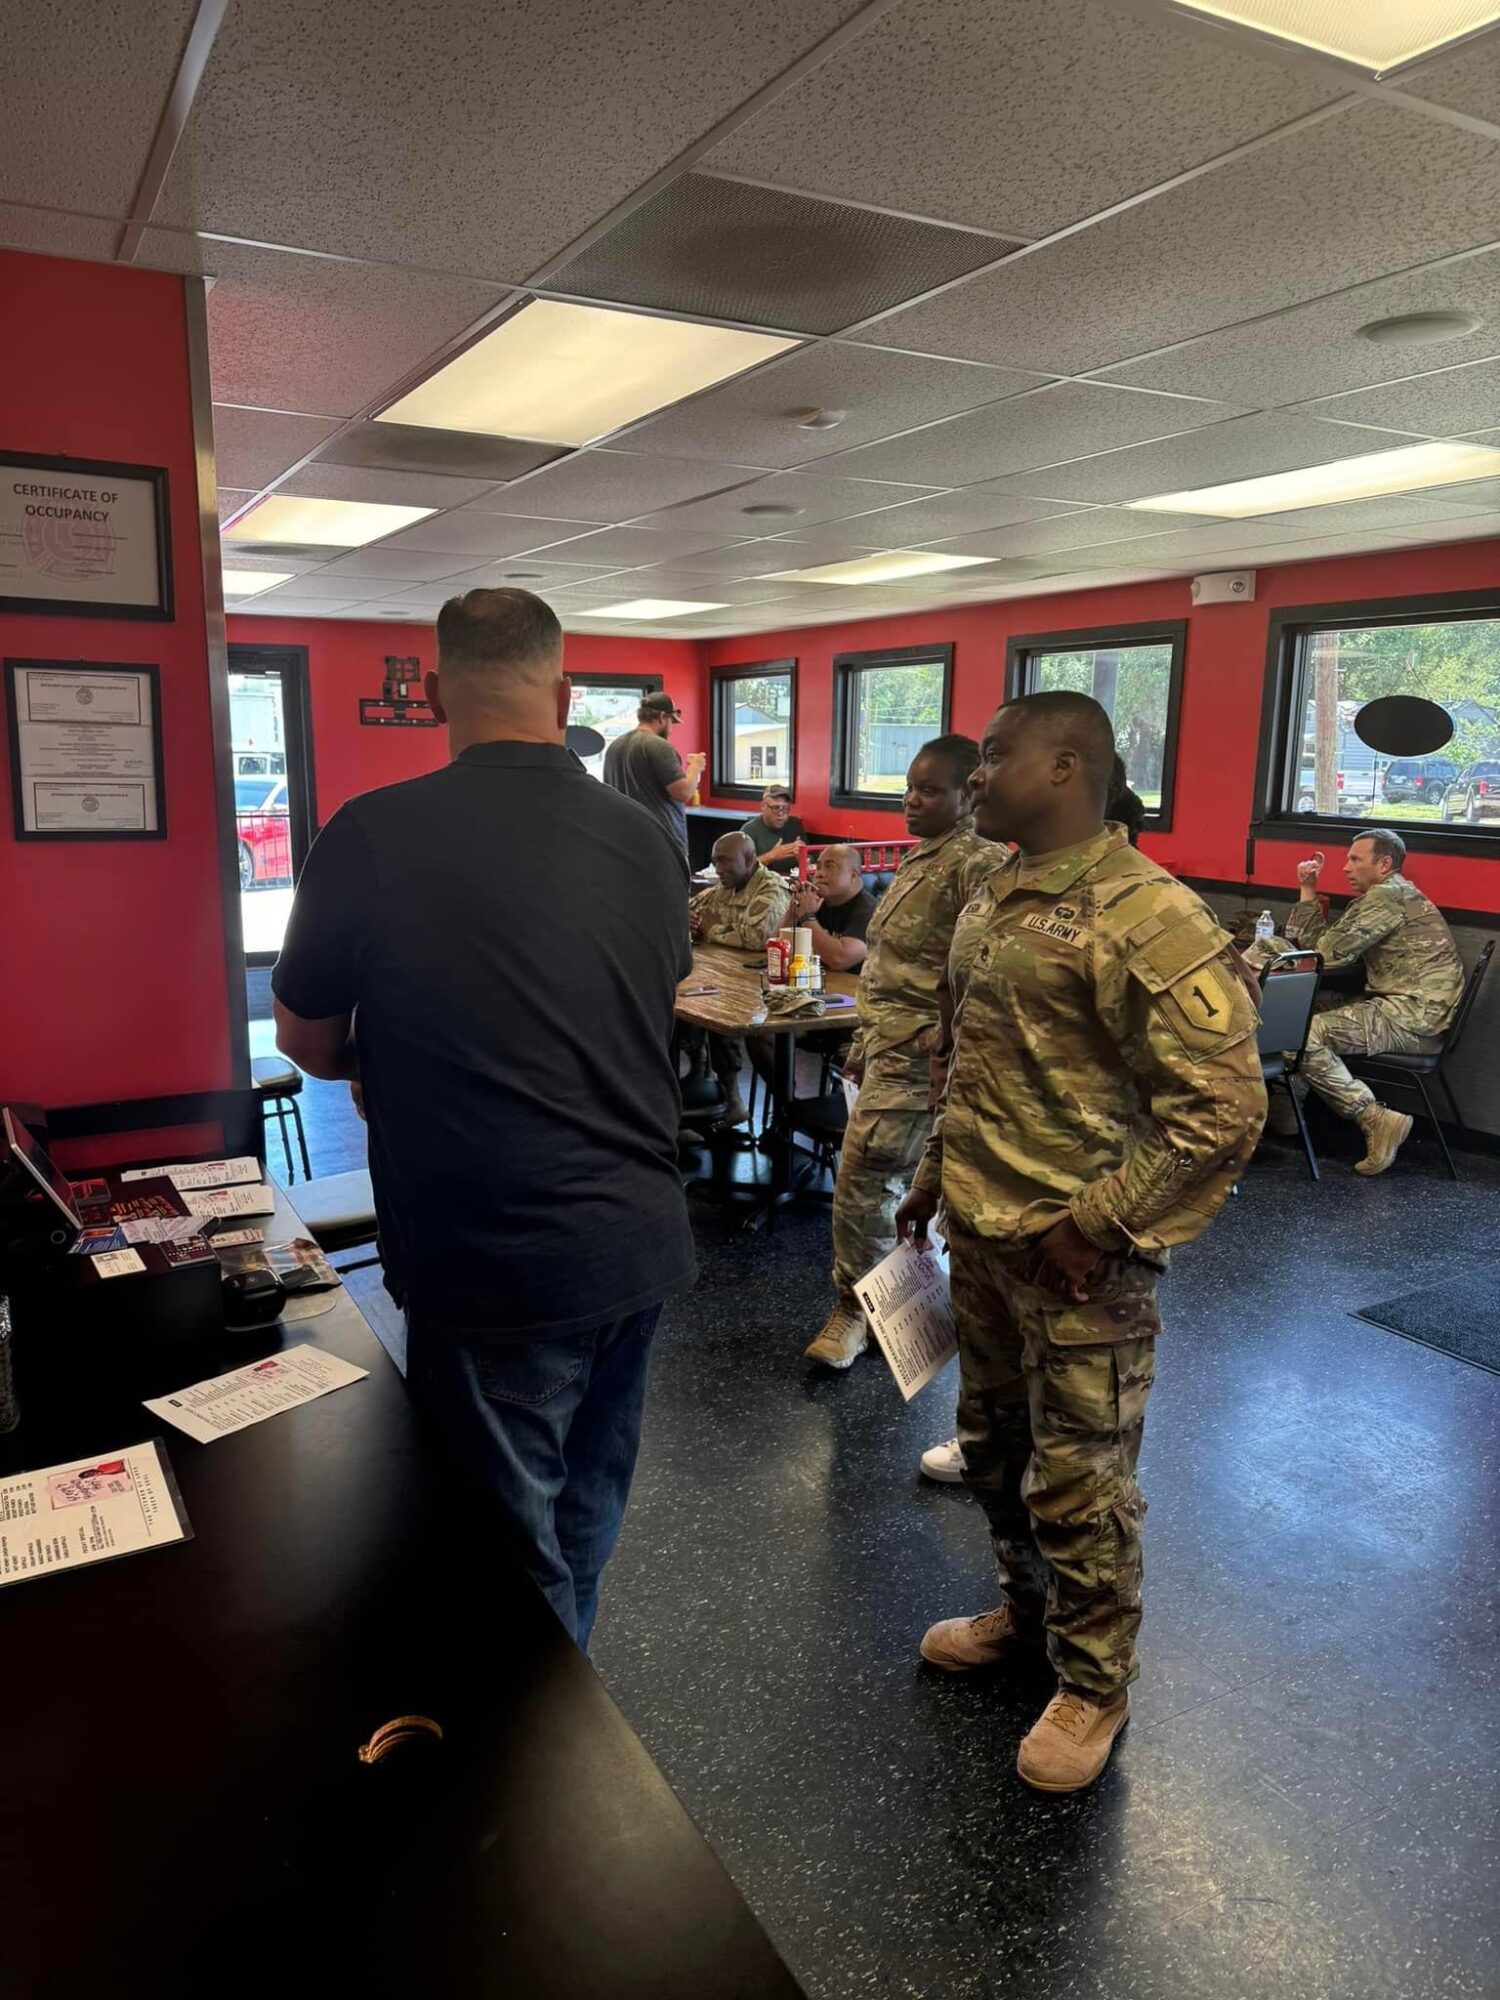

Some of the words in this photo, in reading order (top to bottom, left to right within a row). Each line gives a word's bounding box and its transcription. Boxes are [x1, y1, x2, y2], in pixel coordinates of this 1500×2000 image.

[13, 483, 98, 502] CERTIFICATE
[100, 492, 119, 504] OF
[25, 504, 109, 522] OCCUPANCY
